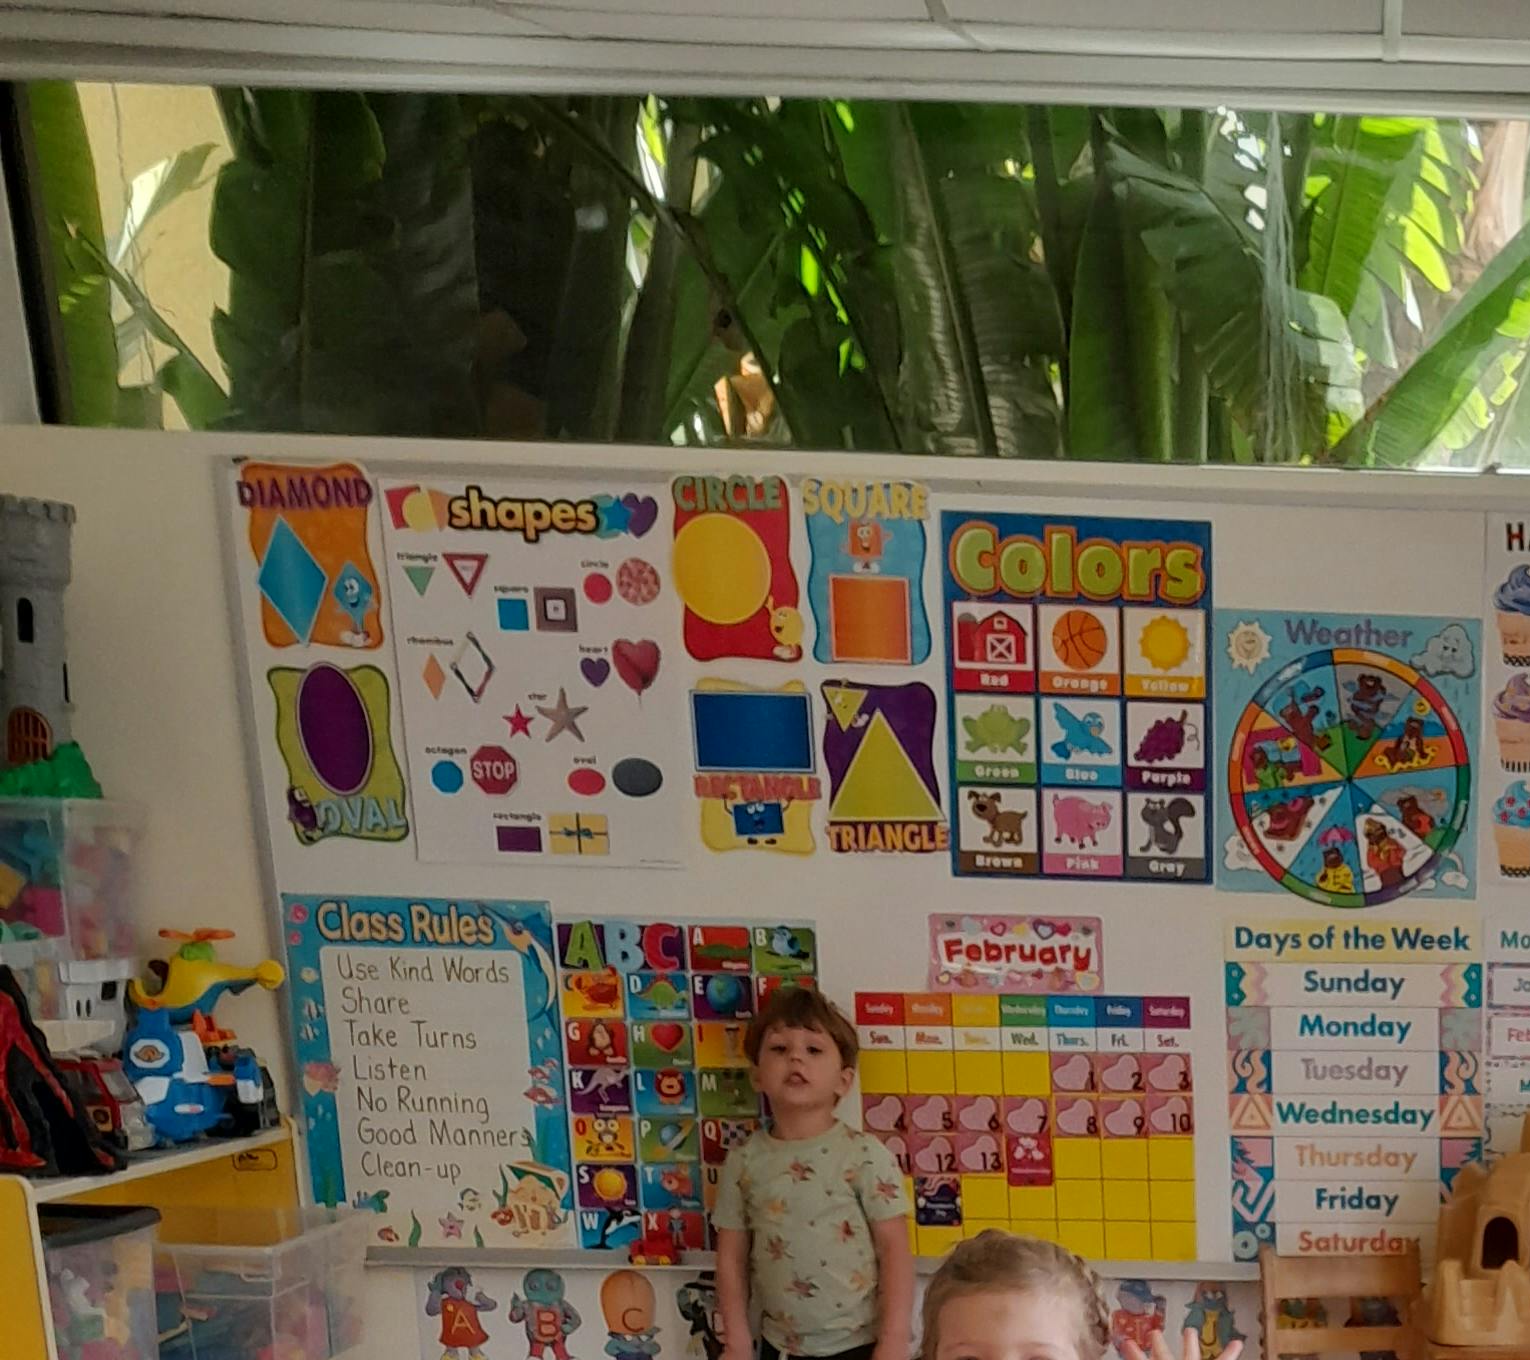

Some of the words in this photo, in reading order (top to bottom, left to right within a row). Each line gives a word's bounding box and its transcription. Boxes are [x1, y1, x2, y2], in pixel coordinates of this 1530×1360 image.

[237, 476, 373, 508] DIAMOND
[673, 475, 782, 512] CIRCLE
[803, 478, 930, 520] SQUARE
[448, 486, 598, 542] shapes
[950, 520, 1206, 601] Colors
[1284, 618, 1414, 649] Weather
[980, 673, 1009, 688] Red
[1052, 676, 1109, 692] Orange
[1141, 679, 1190, 693] Yellow
[473, 761, 516, 780] STOP
[974, 765, 1020, 779] Green
[1065, 767, 1099, 782] Blue
[1142, 770, 1192, 787] Purple
[693, 772, 822, 801] RECTANGLE
[318, 796, 406, 836] OVAL
[827, 822, 949, 853] TRIANGLE
[975, 854, 1023, 869] Brown
[1066, 856, 1100, 871] Pink
[1149, 860, 1186, 877] Gray
[317, 901, 405, 942] Class
[410, 903, 495, 945] Rules
[565, 920, 680, 974] ABC
[693, 927, 704, 946] A
[755, 928, 767, 947] B
[1234, 926, 1301, 956] Days
[1309, 926, 1337, 950] of
[1343, 927, 1387, 950] the
[1392, 927, 1470, 952] Week
[943, 938, 1092, 972] February
[337, 954, 379, 981] Use
[389, 955, 434, 985] Kind
[443, 956, 510, 985] Words
[1303, 963, 1405, 998] Sunday
[630, 975, 642, 994] D
[694, 976, 705, 995] E
[758, 977, 767, 996] F
[341, 988, 410, 1015] Share
[344, 1019, 398, 1048] Take
[410, 1020, 477, 1049] Turns
[568, 1021, 581, 1041] G
[633, 1025, 645, 1043] H
[1056, 1032, 1089, 1047] Thurs.
[1299, 1012, 1412, 1043] Monday
[352, 1056, 427, 1082] Listen
[571, 1071, 585, 1089] K
[1087, 1069, 1096, 1091] 1
[1131, 1071, 1144, 1091] 2
[1178, 1070, 1191, 1091] 3
[1300, 1057, 1409, 1087] Tuesday
[637, 1073, 646, 1091] L
[701, 1073, 718, 1092] M
[356, 1087, 387, 1112] No
[397, 1087, 490, 1124] Running
[1275, 1101, 1436, 1132] Wednesday
[357, 1117, 416, 1146] Good
[430, 1121, 531, 1148] Manners
[575, 1118, 587, 1136] O
[640, 1120, 652, 1138] P
[703, 1121, 718, 1140] Q
[893, 1111, 905, 1130] 4
[941, 1111, 953, 1130] 5
[988, 1112, 999, 1131] 6
[1037, 1115, 1048, 1134] 7
[1086, 1114, 1098, 1134] 8
[1132, 1115, 1145, 1136] 9
[1171, 1112, 1192, 1133] 10
[361, 1152, 462, 1184] Clean-up
[896, 1152, 911, 1175] 11
[936, 1153, 957, 1174] 12
[981, 1151, 1001, 1172] 13
[1295, 1143, 1418, 1173] Thursday
[579, 1165, 590, 1183] S
[644, 1166, 654, 1184] T
[707, 1168, 718, 1185] U
[1315, 1187, 1399, 1217] Friday
[583, 1212, 599, 1230] W
[647, 1212, 659, 1230] X
[452, 1307, 476, 1335] A
[537, 1309, 559, 1339] B
[620, 1307, 646, 1332] C
